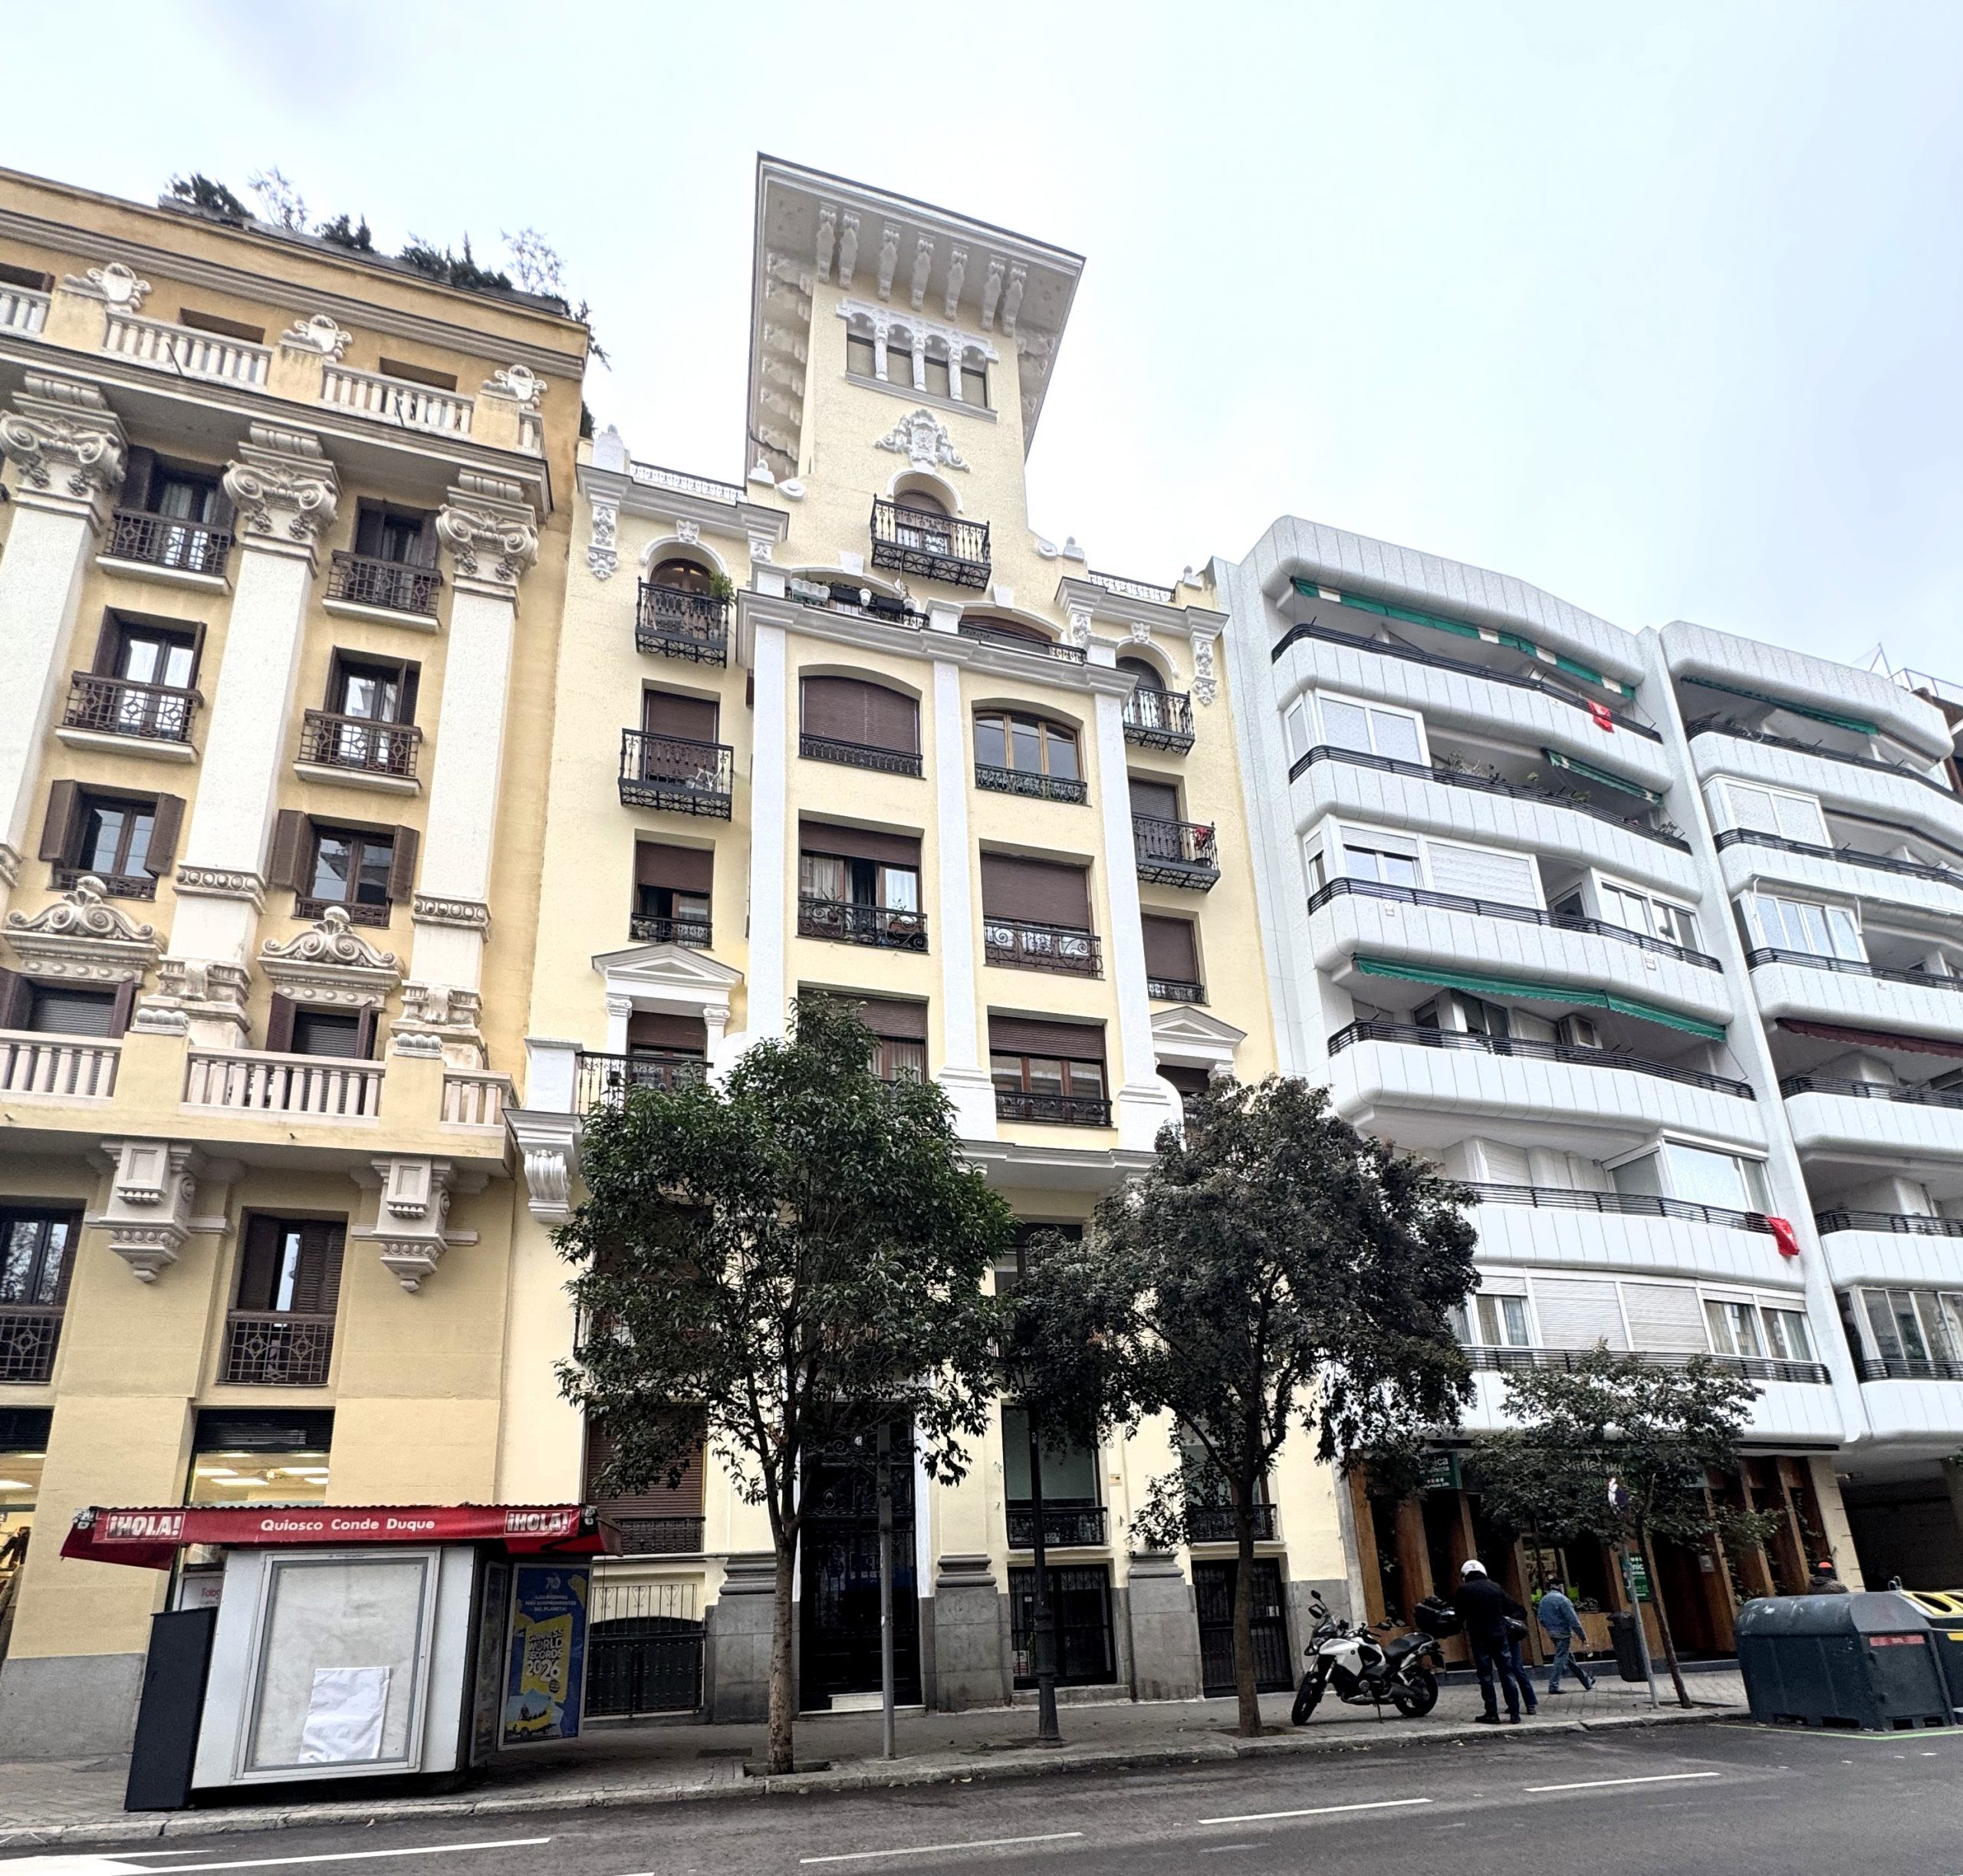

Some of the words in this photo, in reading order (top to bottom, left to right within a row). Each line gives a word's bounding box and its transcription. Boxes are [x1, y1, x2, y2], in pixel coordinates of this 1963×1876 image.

[110, 1516, 182, 1536] ¡HOLA!
[261, 1519, 324, 1531] Quiosco
[331, 1518, 380, 1530] Conde
[386, 1518, 436, 1532] Duque
[507, 1512, 568, 1532] ¡HOLA!
[529, 1637, 563, 1651] WORLD
[526, 1659, 560, 1682] 2026
